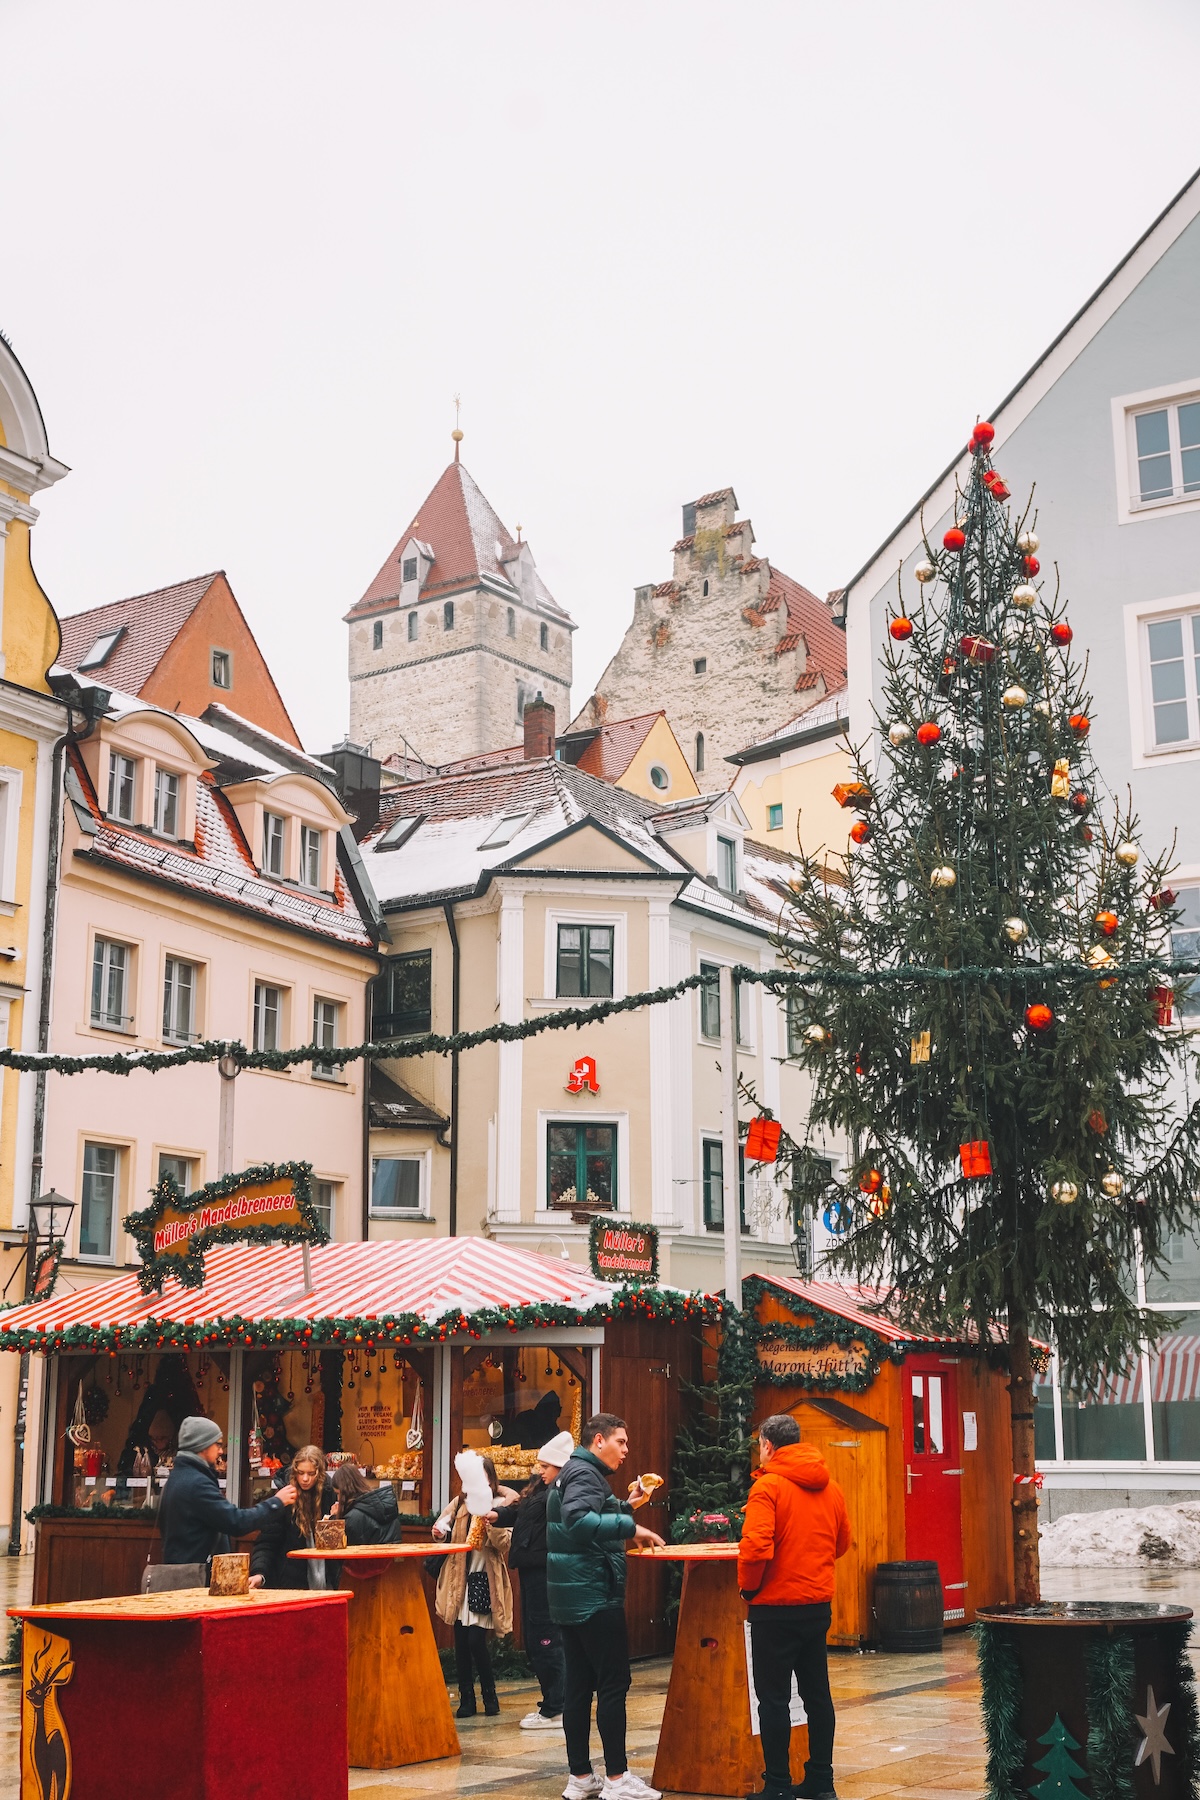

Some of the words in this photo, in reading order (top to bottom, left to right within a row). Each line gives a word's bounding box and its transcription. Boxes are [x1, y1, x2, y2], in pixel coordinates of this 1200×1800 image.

[200, 1193, 297, 1230] Mandelbrennerei
[603, 1230, 645, 1253] Müller's
[597, 1251, 652, 1271] Mandelbrennerei
[760, 1341, 831, 1356] Regensbrger
[760, 1357, 862, 1374] Maroni-Hütt'n
